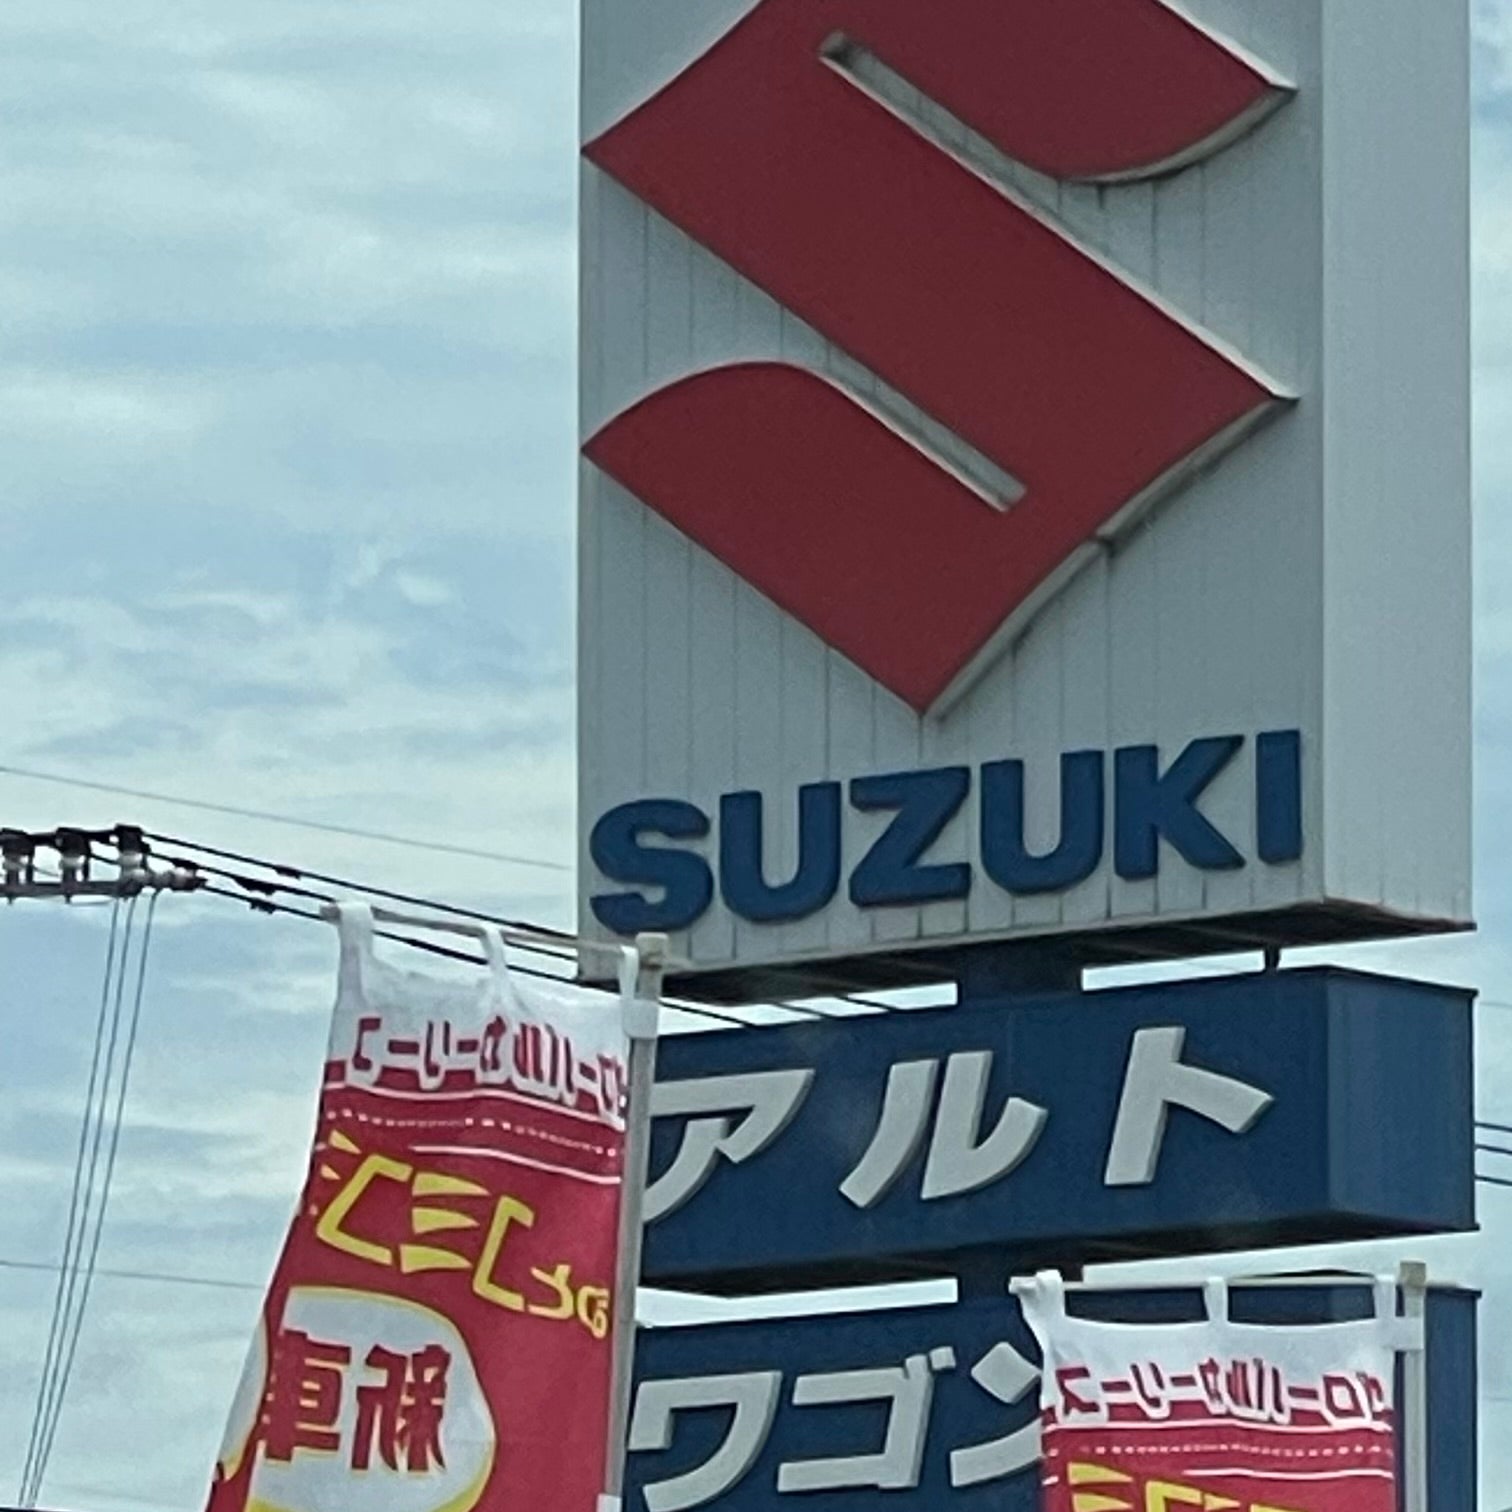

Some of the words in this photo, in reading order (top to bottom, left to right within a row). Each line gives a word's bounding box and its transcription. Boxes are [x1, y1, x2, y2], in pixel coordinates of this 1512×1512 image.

[589, 729, 1302, 934] SUZUKI
[643, 1026, 1274, 1222] アルト
